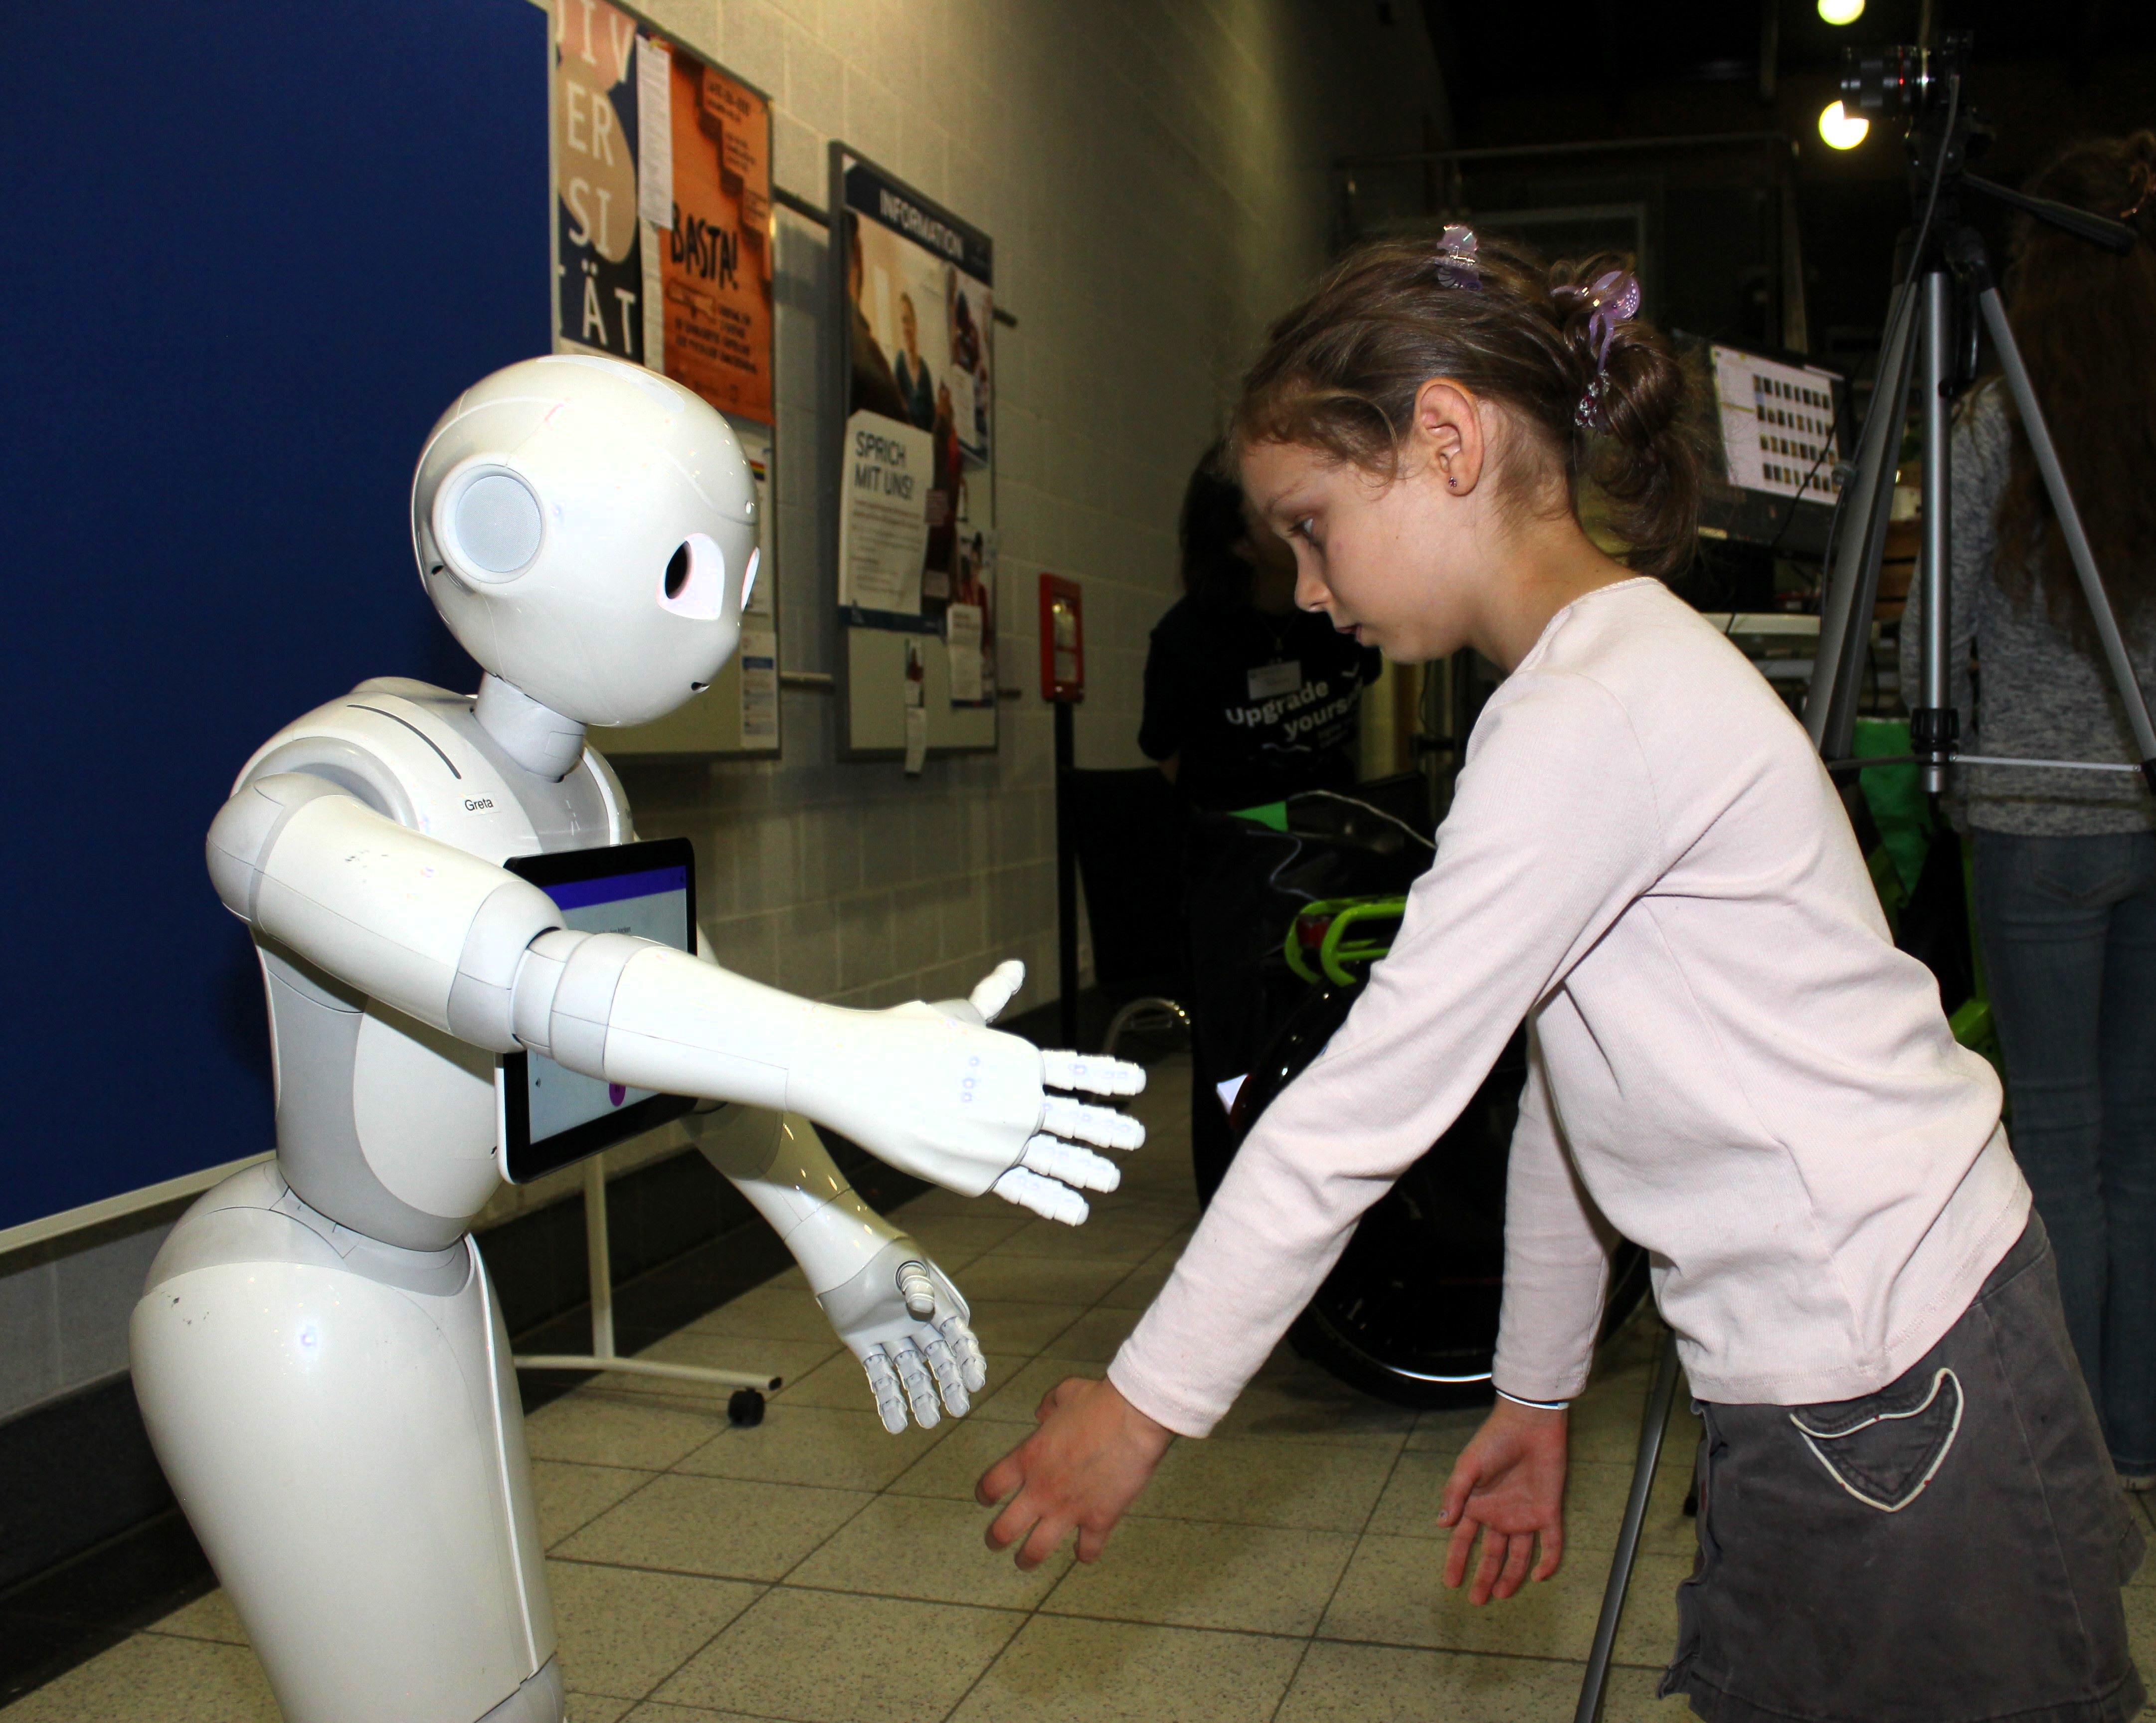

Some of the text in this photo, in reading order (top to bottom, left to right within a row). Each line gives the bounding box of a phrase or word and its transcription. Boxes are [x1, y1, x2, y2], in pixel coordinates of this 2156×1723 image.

[567, 83, 615, 167] ER
[568, 178, 611, 255] SI
[671, 202, 738, 290] BASTA!
[855, 430, 906, 466] SPRICH
[854, 463, 881, 492] MIT
[1225, 681, 1328, 727] Upgrade
[465, 799, 494, 811] Greta
